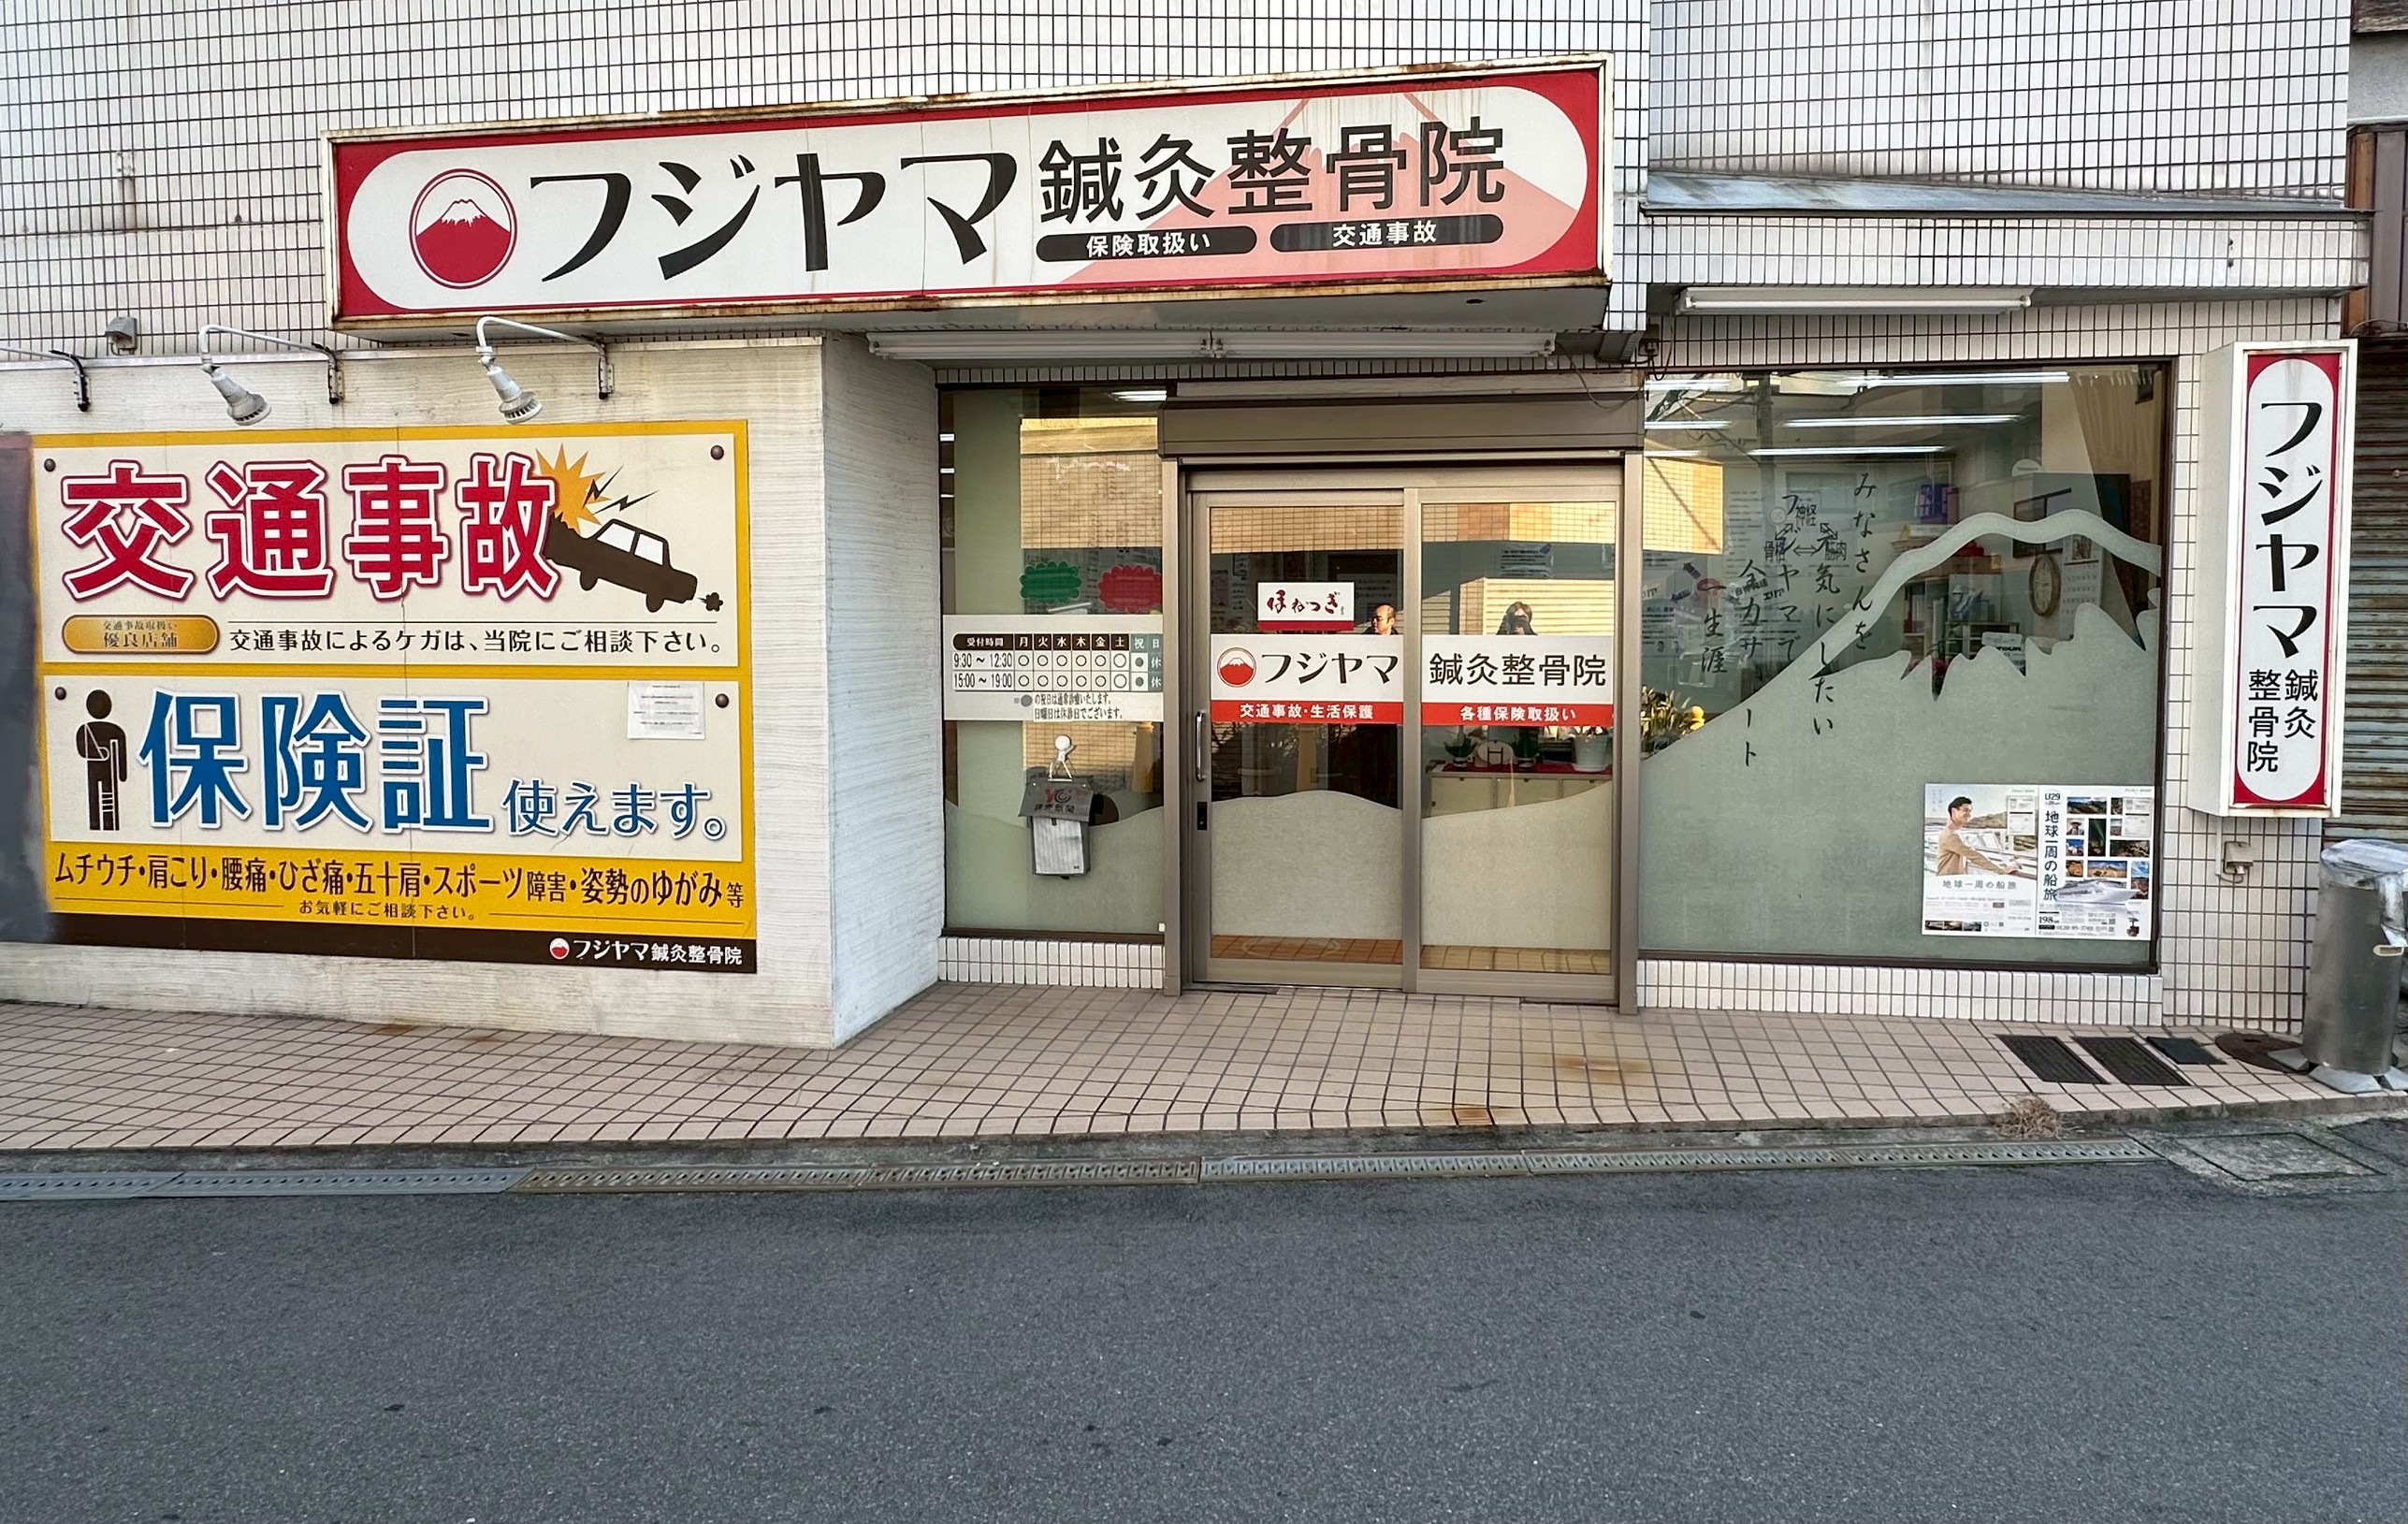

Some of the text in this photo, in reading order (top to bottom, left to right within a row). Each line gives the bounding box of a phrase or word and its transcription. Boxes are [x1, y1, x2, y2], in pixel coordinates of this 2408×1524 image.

[529, 116, 1504, 283] フジヤマ 鍼灸整骨院
[1085, 232, 1211, 257] 保険取扱い
[1331, 221, 1438, 247] 交通事故
[62, 454, 562, 602] 交通事故
[2252, 399, 2323, 660] フジヤマ
[1852, 472, 1878, 650] みなさんを
[1266, 588, 1341, 615] ほねつぎ
[103, 631, 178, 648] 優良店舗
[228, 629, 722, 654] 交通事故によるケガは、当院にご相談下さい。
[966, 636, 1160, 649] 受付時間 月 火 水 木 金 土 祝 日
[954, 652, 972, 668] 9:30
[990, 652, 1013, 668] 12:30
[1151, 657, 1162, 669] 休
[1261, 652, 1399, 685] フジヤマ
[1429, 653, 1607, 688] 鍼灸整骨院
[954, 673, 975, 688] 15:00
[991, 673, 1013, 688] 19:00
[1151, 675, 1162, 689] 休
[1240, 704, 1373, 719] 交通事故・生活保護
[1460, 706, 1576, 722] 各種保険取扱い
[2283, 669, 2319, 740] 鍼灸
[2246, 669, 2282, 774] 整骨院
[139, 690, 728, 842] 保険証 使えます。
[2043, 810, 2059, 902] 地球一周の船旅
[1942, 879, 2017, 890] 地球一周の船旅
[297, 899, 475, 921] お気軽にご相談下さい。
[573, 939, 744, 965] フジヤマ鍼灸整骨院
